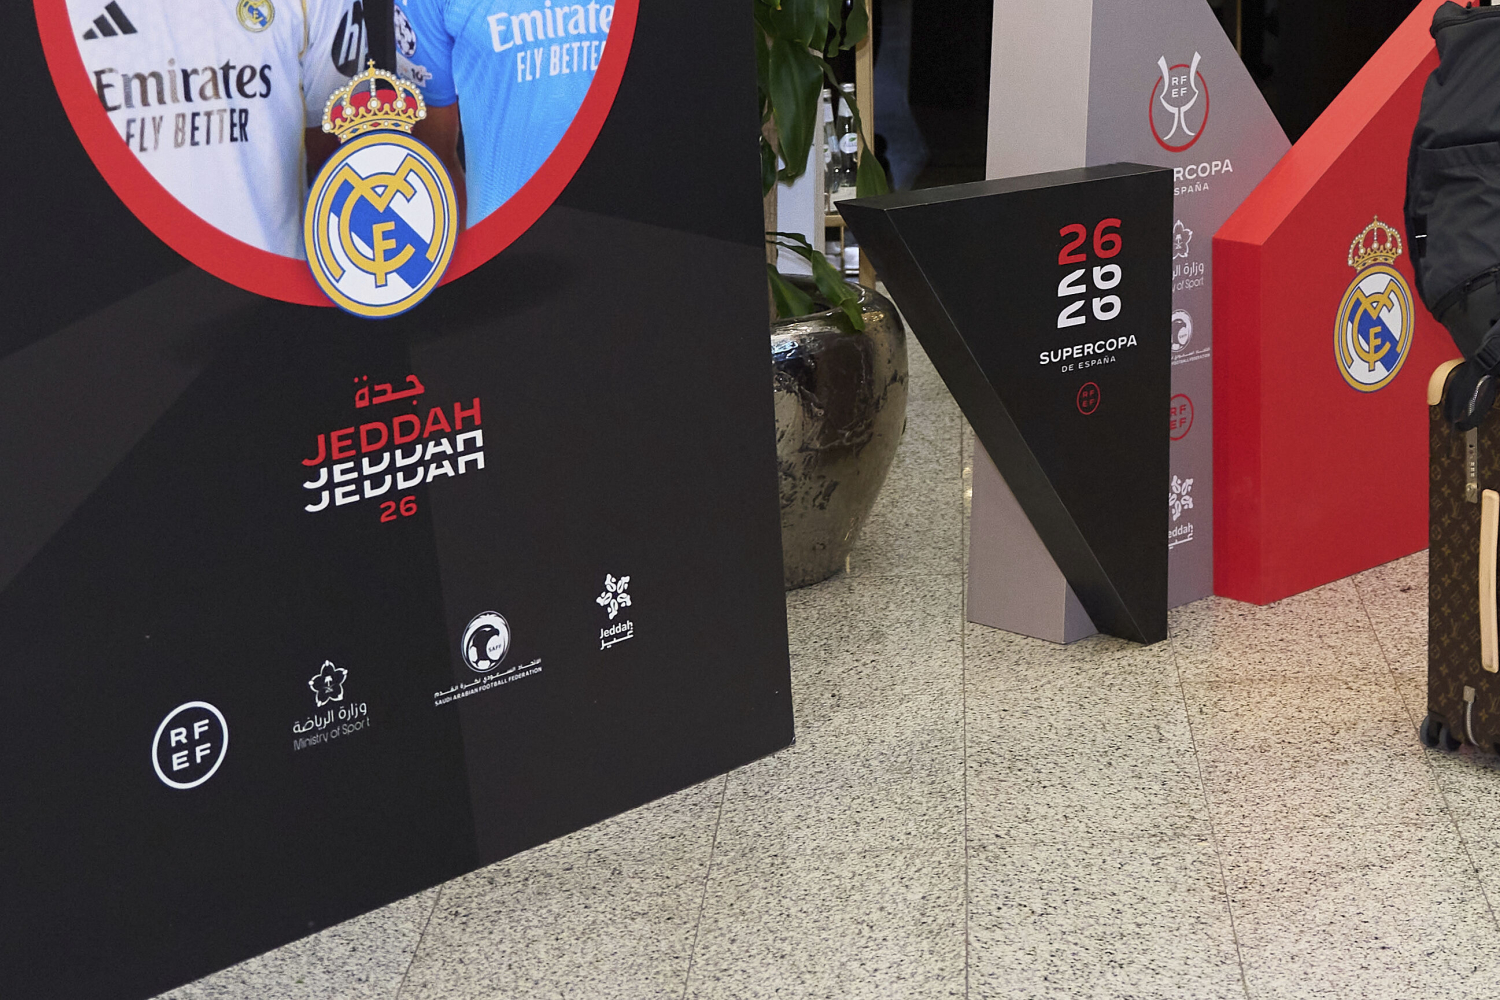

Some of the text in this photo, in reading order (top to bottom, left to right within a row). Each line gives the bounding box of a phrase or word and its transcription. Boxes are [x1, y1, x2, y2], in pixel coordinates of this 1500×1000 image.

[487, 0, 614, 52] Emirate
[517, 47, 543, 82] FLY
[93, 58, 272, 112] Emirates
[126, 108, 249, 152] FLY BETTER
[1174, 182, 1209, 196] SPAÑA
[1057, 217, 1122, 266] 26
[1039, 334, 1138, 365] SUPERCOPA
[1061, 355, 1116, 373] DE ESPAÑA
[354, 374, 425, 408] جدة
[301, 397, 482, 466] JEDDAH
[379, 495, 418, 523] 26
[1168, 522, 1193, 539] eddah
[600, 620, 633, 639] Jeddah
[434, 666, 542, 707] SAUDI ARABIAN FOOTBALL FEDERATION
[338, 702, 367, 721] وزارة
[293, 732, 329, 751] Ministry
[330, 726, 341, 738] of
